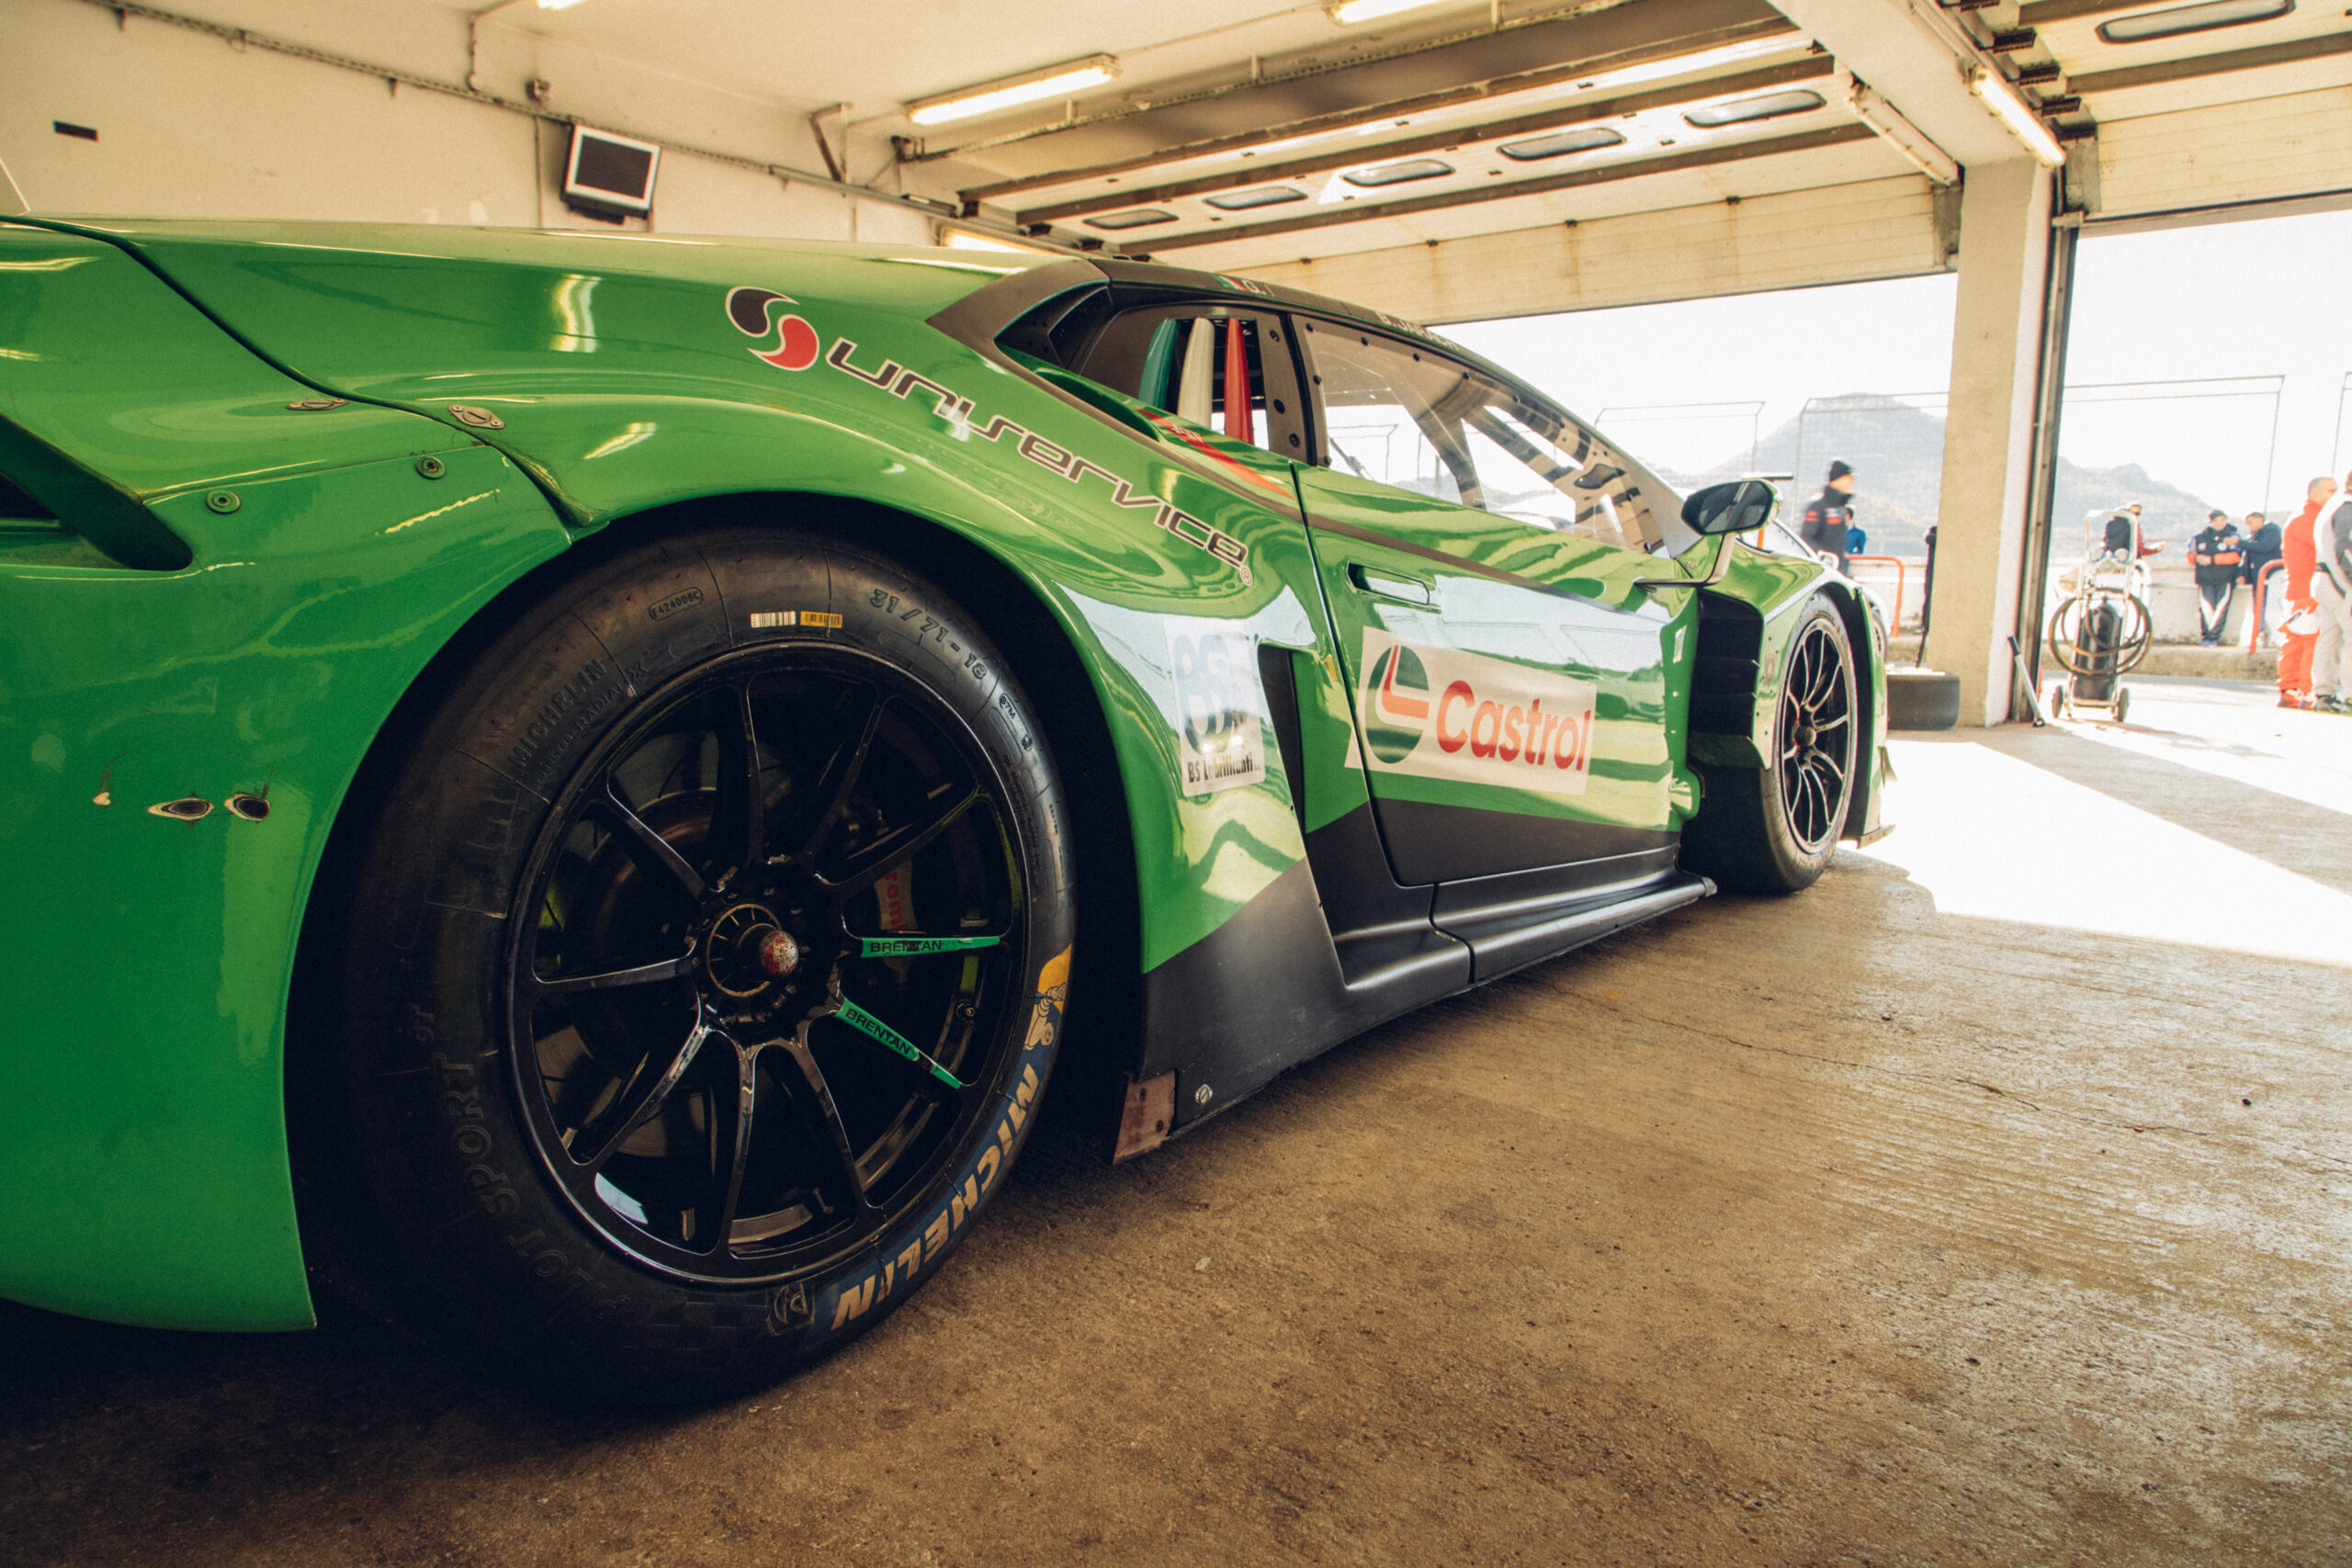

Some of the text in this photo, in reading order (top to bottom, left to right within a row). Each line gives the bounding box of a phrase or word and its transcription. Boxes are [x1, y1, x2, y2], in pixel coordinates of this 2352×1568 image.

[507, 659, 607, 768] MICHELIN
[1436, 680, 1592, 772] Castrol
[845, 1008, 911, 1055] BRENTAN
[434, 1052, 521, 1214] SPORT
[830, 1063, 1040, 1332] MICHELIN
